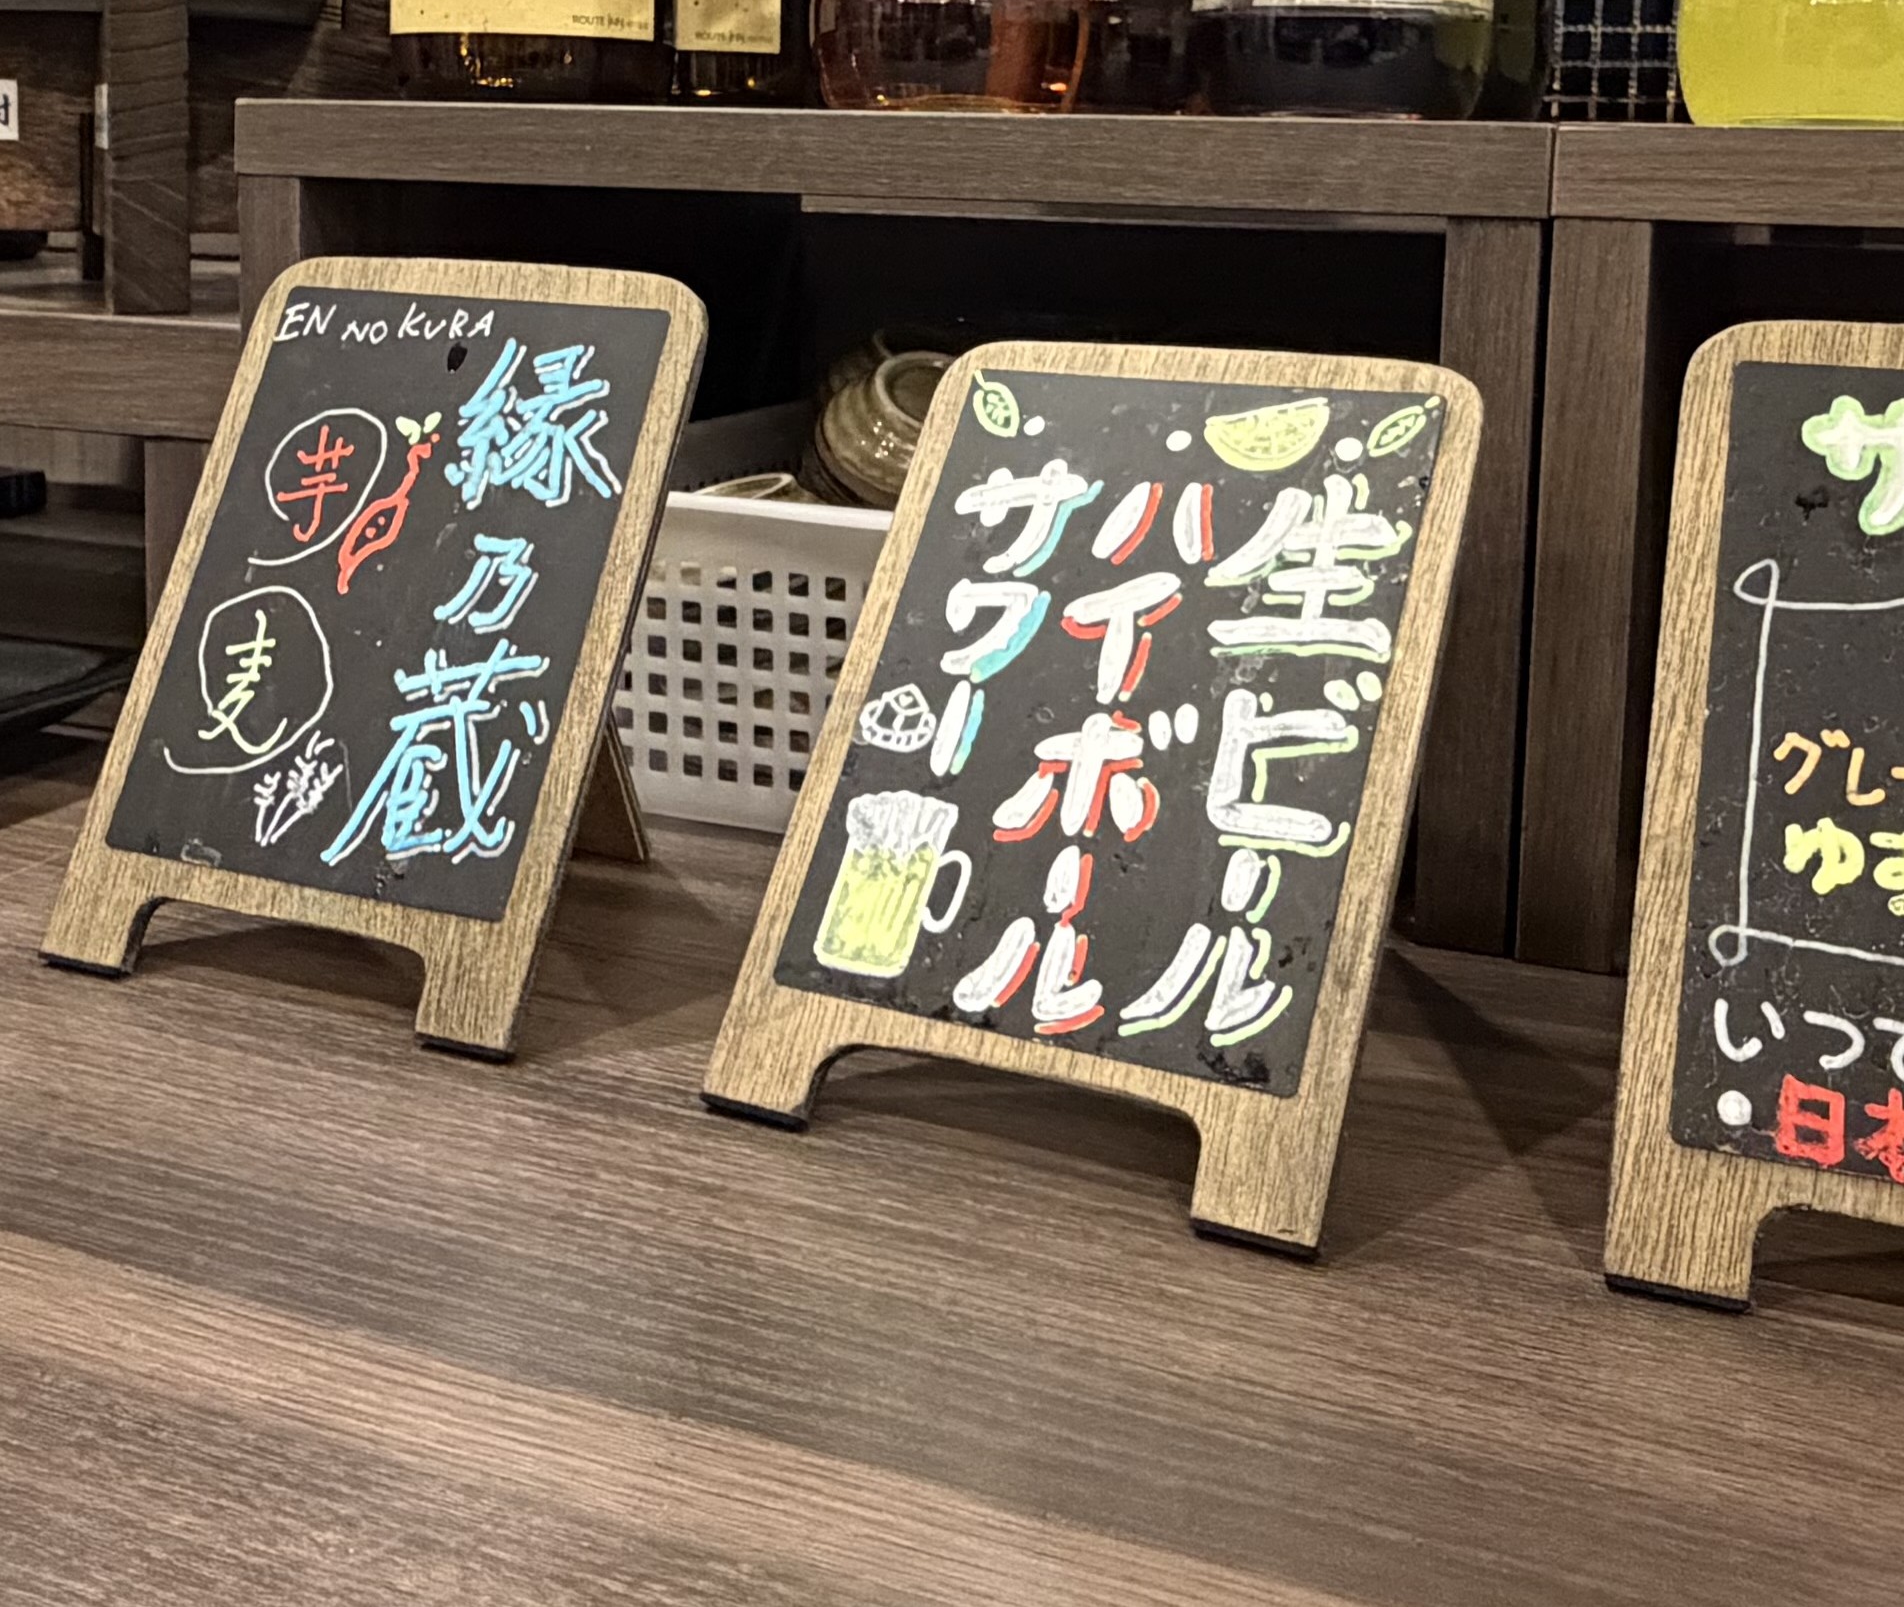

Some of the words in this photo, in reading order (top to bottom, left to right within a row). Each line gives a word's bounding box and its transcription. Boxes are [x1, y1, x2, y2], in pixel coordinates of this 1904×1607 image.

[274, 303, 336, 343] EN
[398, 304, 497, 340] KURA
[277, 423, 355, 542] 芋
[198, 610, 291, 755] 麦
[320, 336, 622, 866] 縁乃蔵
[929, 457, 1104, 778] サワー
[953, 480, 1215, 1035] ハイボール
[1119, 474, 1413, 1047] 生ビール
